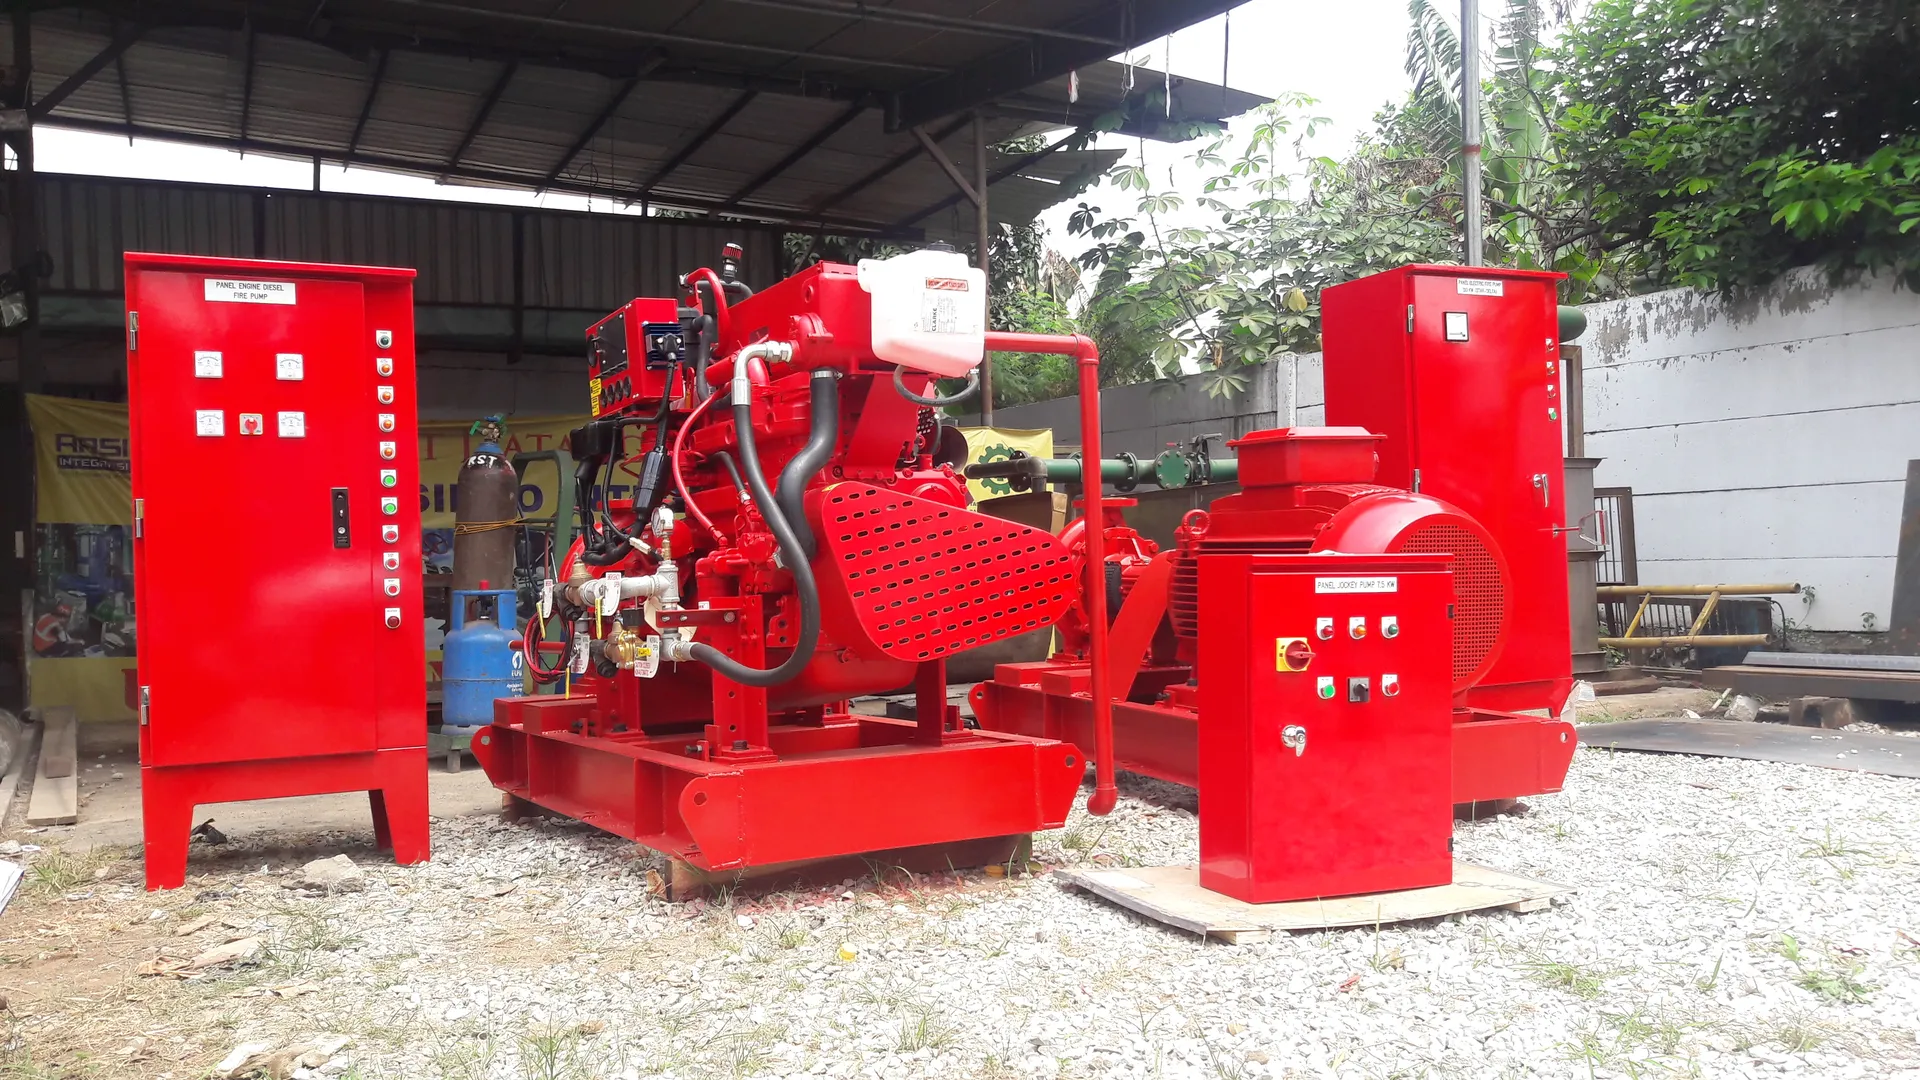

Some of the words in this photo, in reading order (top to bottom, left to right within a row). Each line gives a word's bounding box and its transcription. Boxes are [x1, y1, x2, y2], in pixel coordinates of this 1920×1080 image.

[216, 281, 236, 289] PANEL
[238, 282, 261, 290] ENGINE
[262, 283, 285, 292] DIESEL
[233, 291, 248, 299] FIRE
[250, 292, 268, 300] PUMP
[468, 454, 498, 469] RST
[1317, 581, 1336, 589] PANEL
[1337, 580, 1358, 589] JOCKEY
[1359, 580, 1376, 589] PUMP
[1386, 580, 1396, 588] KW
